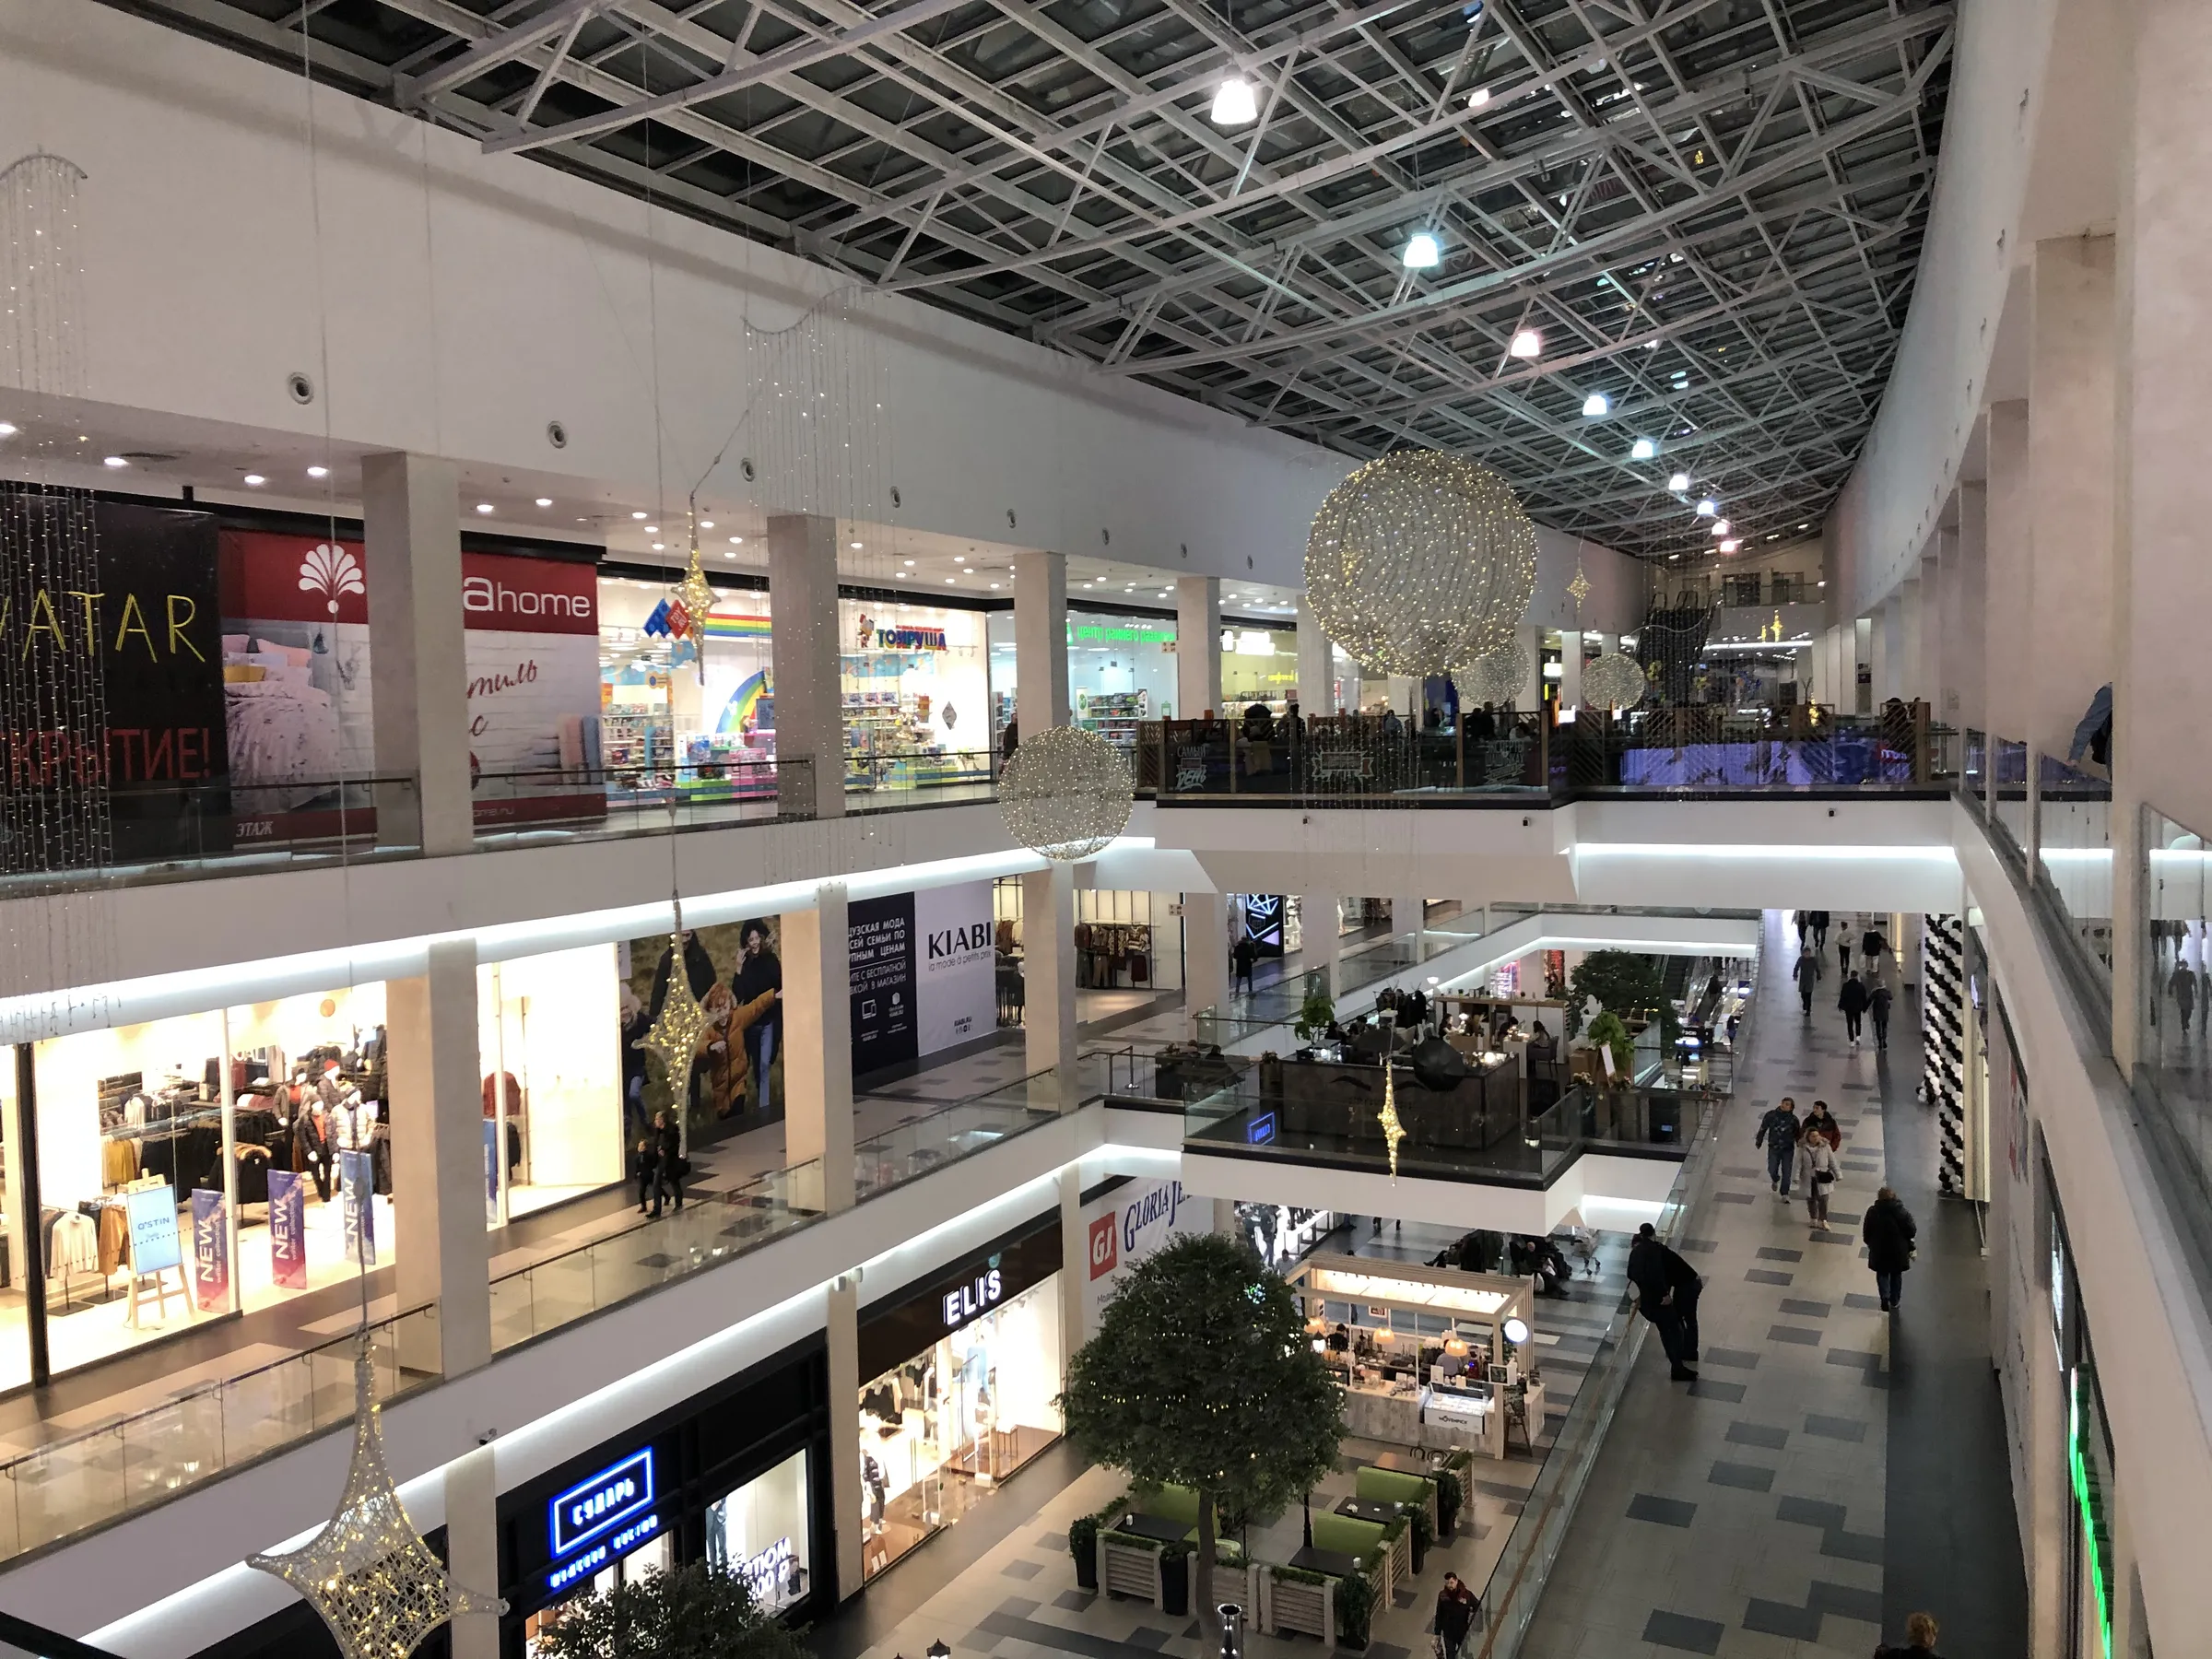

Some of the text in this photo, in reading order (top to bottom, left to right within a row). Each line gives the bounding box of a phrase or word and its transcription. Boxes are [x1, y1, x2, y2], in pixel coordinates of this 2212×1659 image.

[0, 726, 211, 787] КРЫТИЕ!
[235, 820, 275, 838] ЭТАЖ
[866, 933, 891, 947] СЕМЬИ
[894, 929, 905, 940] ПО
[882, 917, 905, 930] МОДА
[928, 922, 992, 959] KIABI
[880, 942, 906, 958] ЦЕНАМ
[935, 957, 956, 971] mode
[877, 972, 907, 988] МАГАЗИН
[343, 1177, 359, 1236] NEW
[1124, 1183, 1170, 1253] GLORIA
[274, 1197, 290, 1260] NEW
[197, 1219, 214, 1283] NEW
[944, 1269, 1001, 1325] ELIS
[571, 1477, 636, 1526] СУДАРЬ
